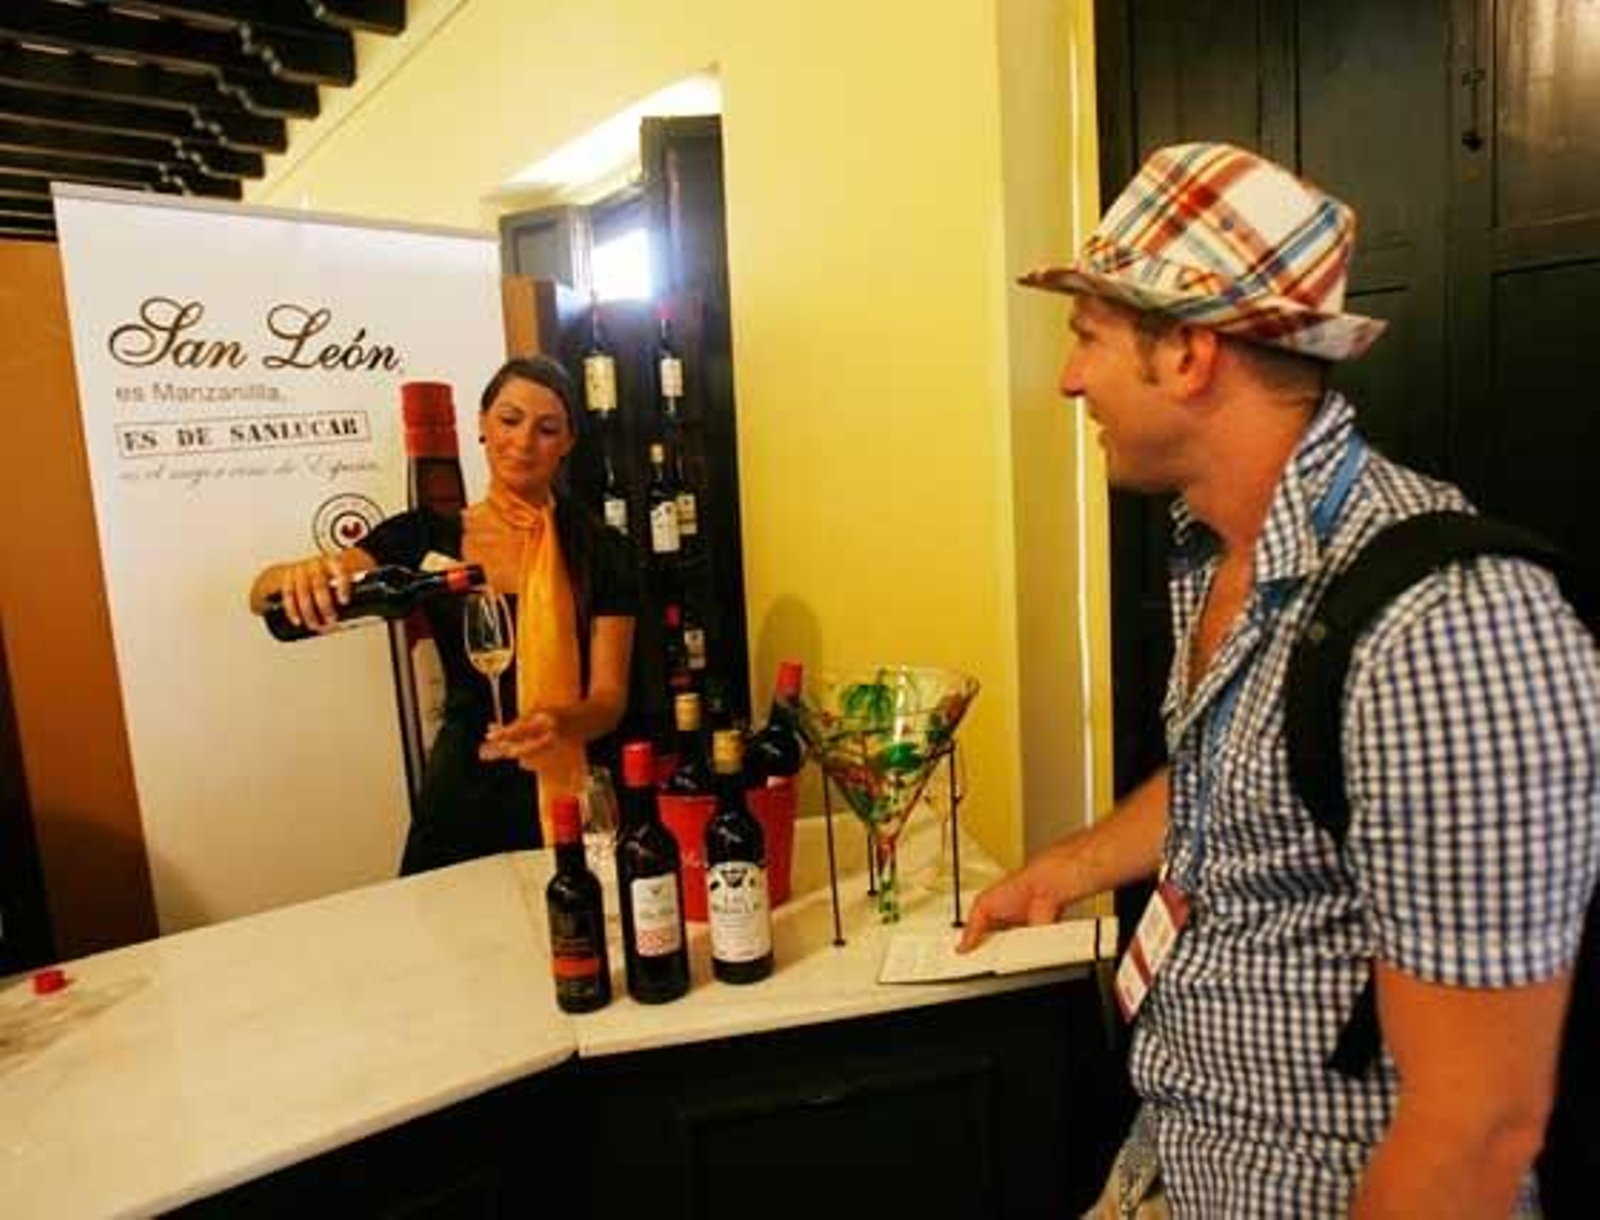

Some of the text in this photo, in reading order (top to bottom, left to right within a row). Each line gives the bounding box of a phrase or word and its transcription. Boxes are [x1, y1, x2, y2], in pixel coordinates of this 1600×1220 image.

[109, 297, 399, 369] San León
[124, 431, 157, 451] ES
[177, 427, 213, 447] DE
